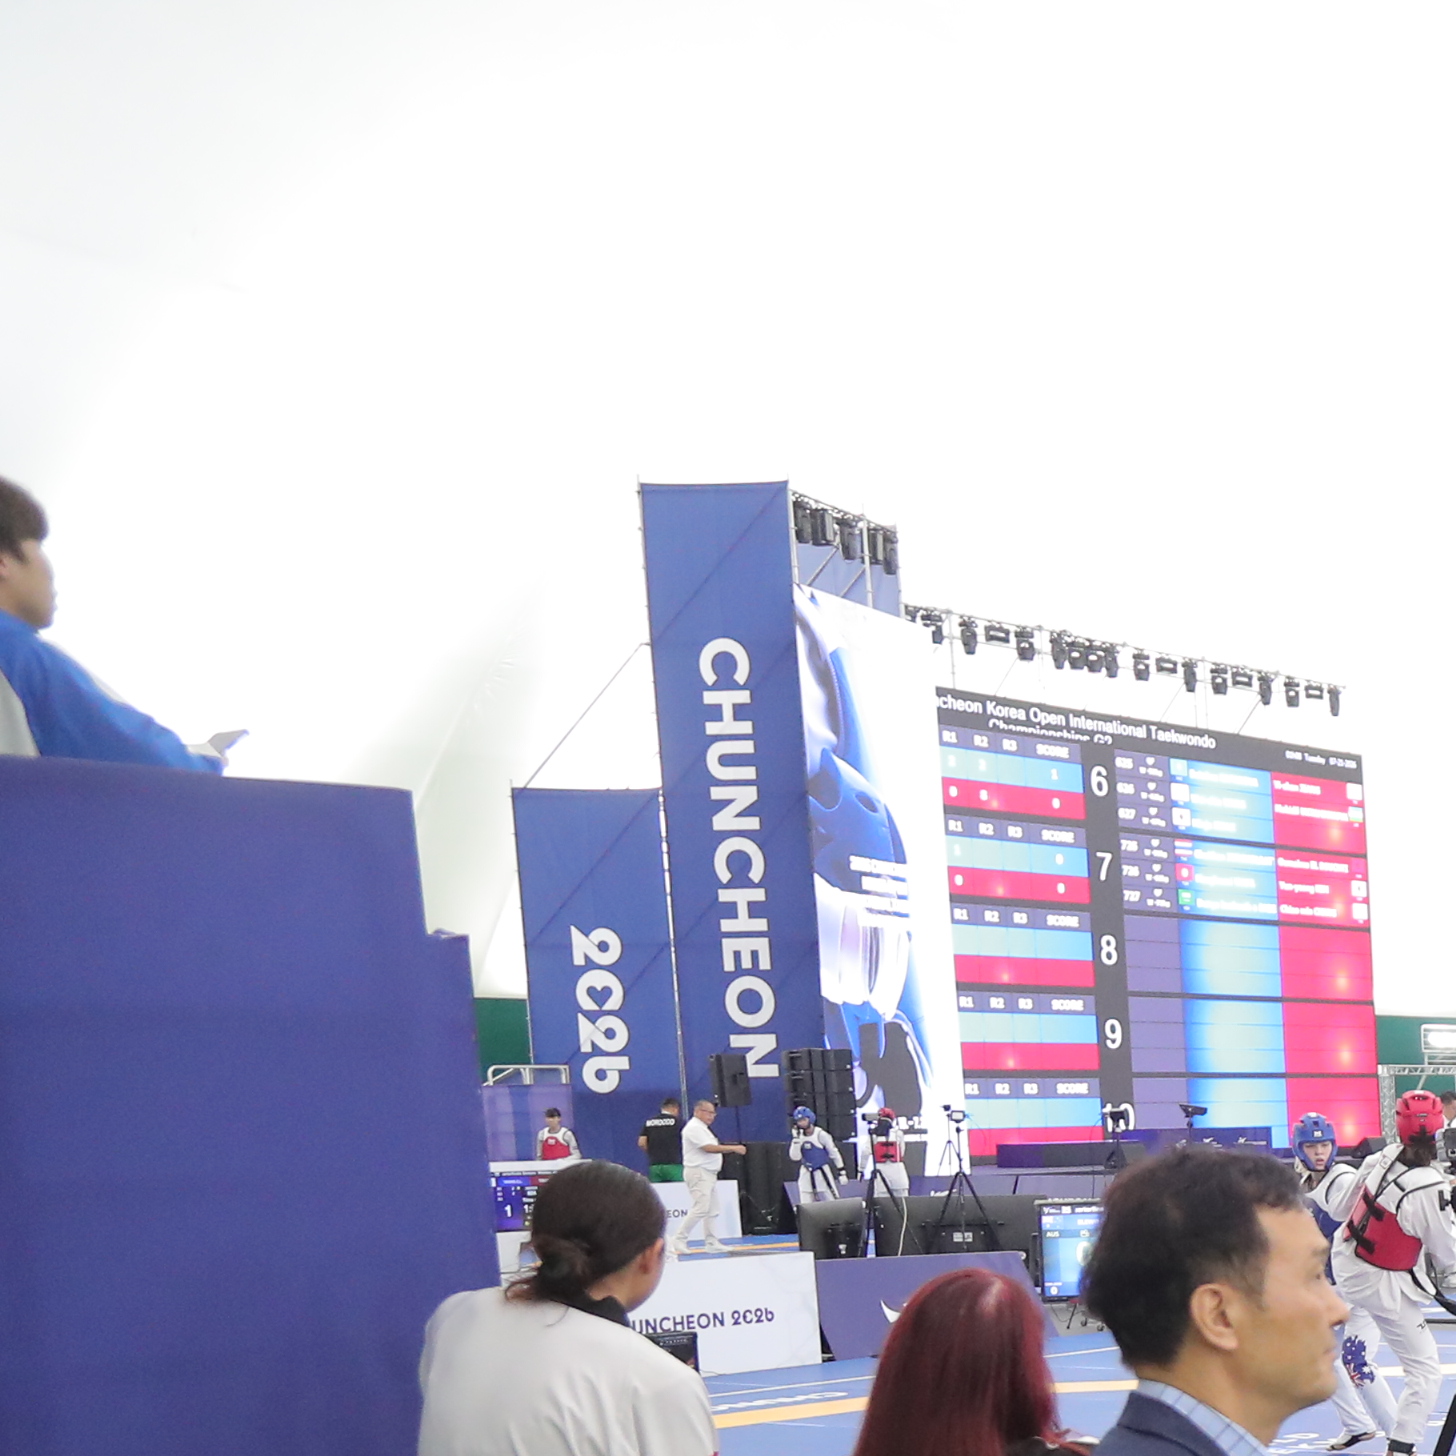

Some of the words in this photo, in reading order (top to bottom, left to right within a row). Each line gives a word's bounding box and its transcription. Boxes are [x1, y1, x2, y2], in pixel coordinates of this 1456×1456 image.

[986, 700, 1026, 721] Korea
[1029, 707, 1066, 726] Open
[1069, 713, 1147, 739] International
[1149, 725, 1217, 749] Taekwondo
[1090, 765, 1109, 797] 6
[698, 636, 780, 1079] CHUNCHEON
[1095, 851, 1113, 881] 7
[1100, 934, 1118, 966] 8
[1104, 1018, 1122, 1049] 9
[504, 1204, 512, 1218] 1
